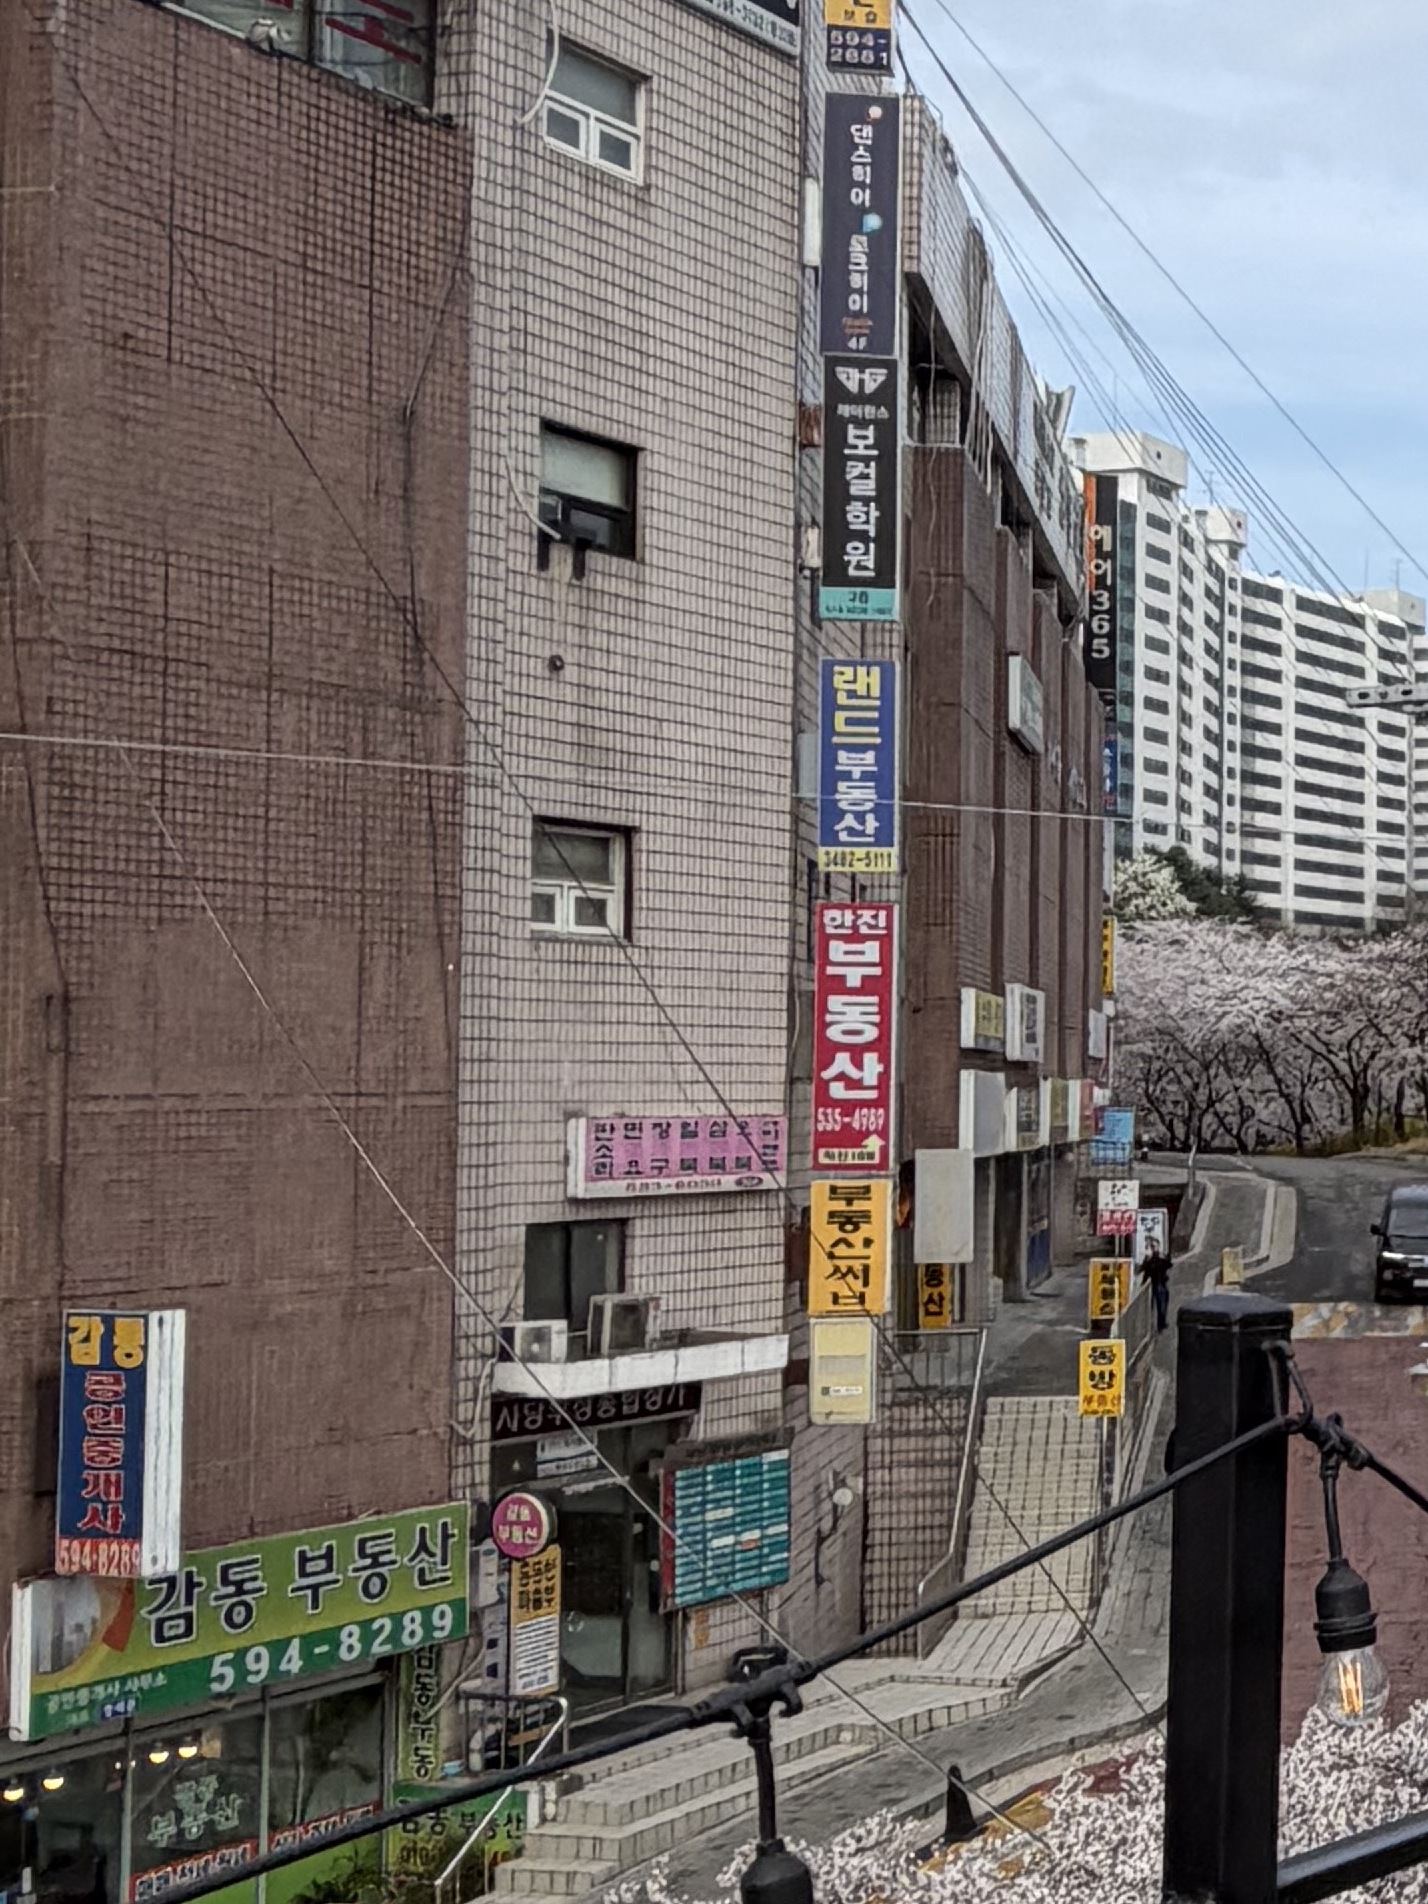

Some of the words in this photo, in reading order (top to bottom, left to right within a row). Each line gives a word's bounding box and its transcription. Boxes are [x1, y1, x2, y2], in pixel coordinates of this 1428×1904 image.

[843, 424, 881, 578] 보컬학원
[832, 665, 882, 744] 랜드
[833, 749, 880, 843] 부동산
[822, 908, 888, 934] 한진
[820, 939, 884, 1100] 부동산
[623, 1121, 644, 1175] 민요
[824, 1184, 876, 1314] 부동산써브
[67, 1315, 146, 1369] 감동
[76, 1370, 127, 1534] 공인중개사
[141, 1554, 268, 1646] 감동
[288, 1518, 458, 1615] 부동산
[209, 1603, 454, 1693] 594-8289
